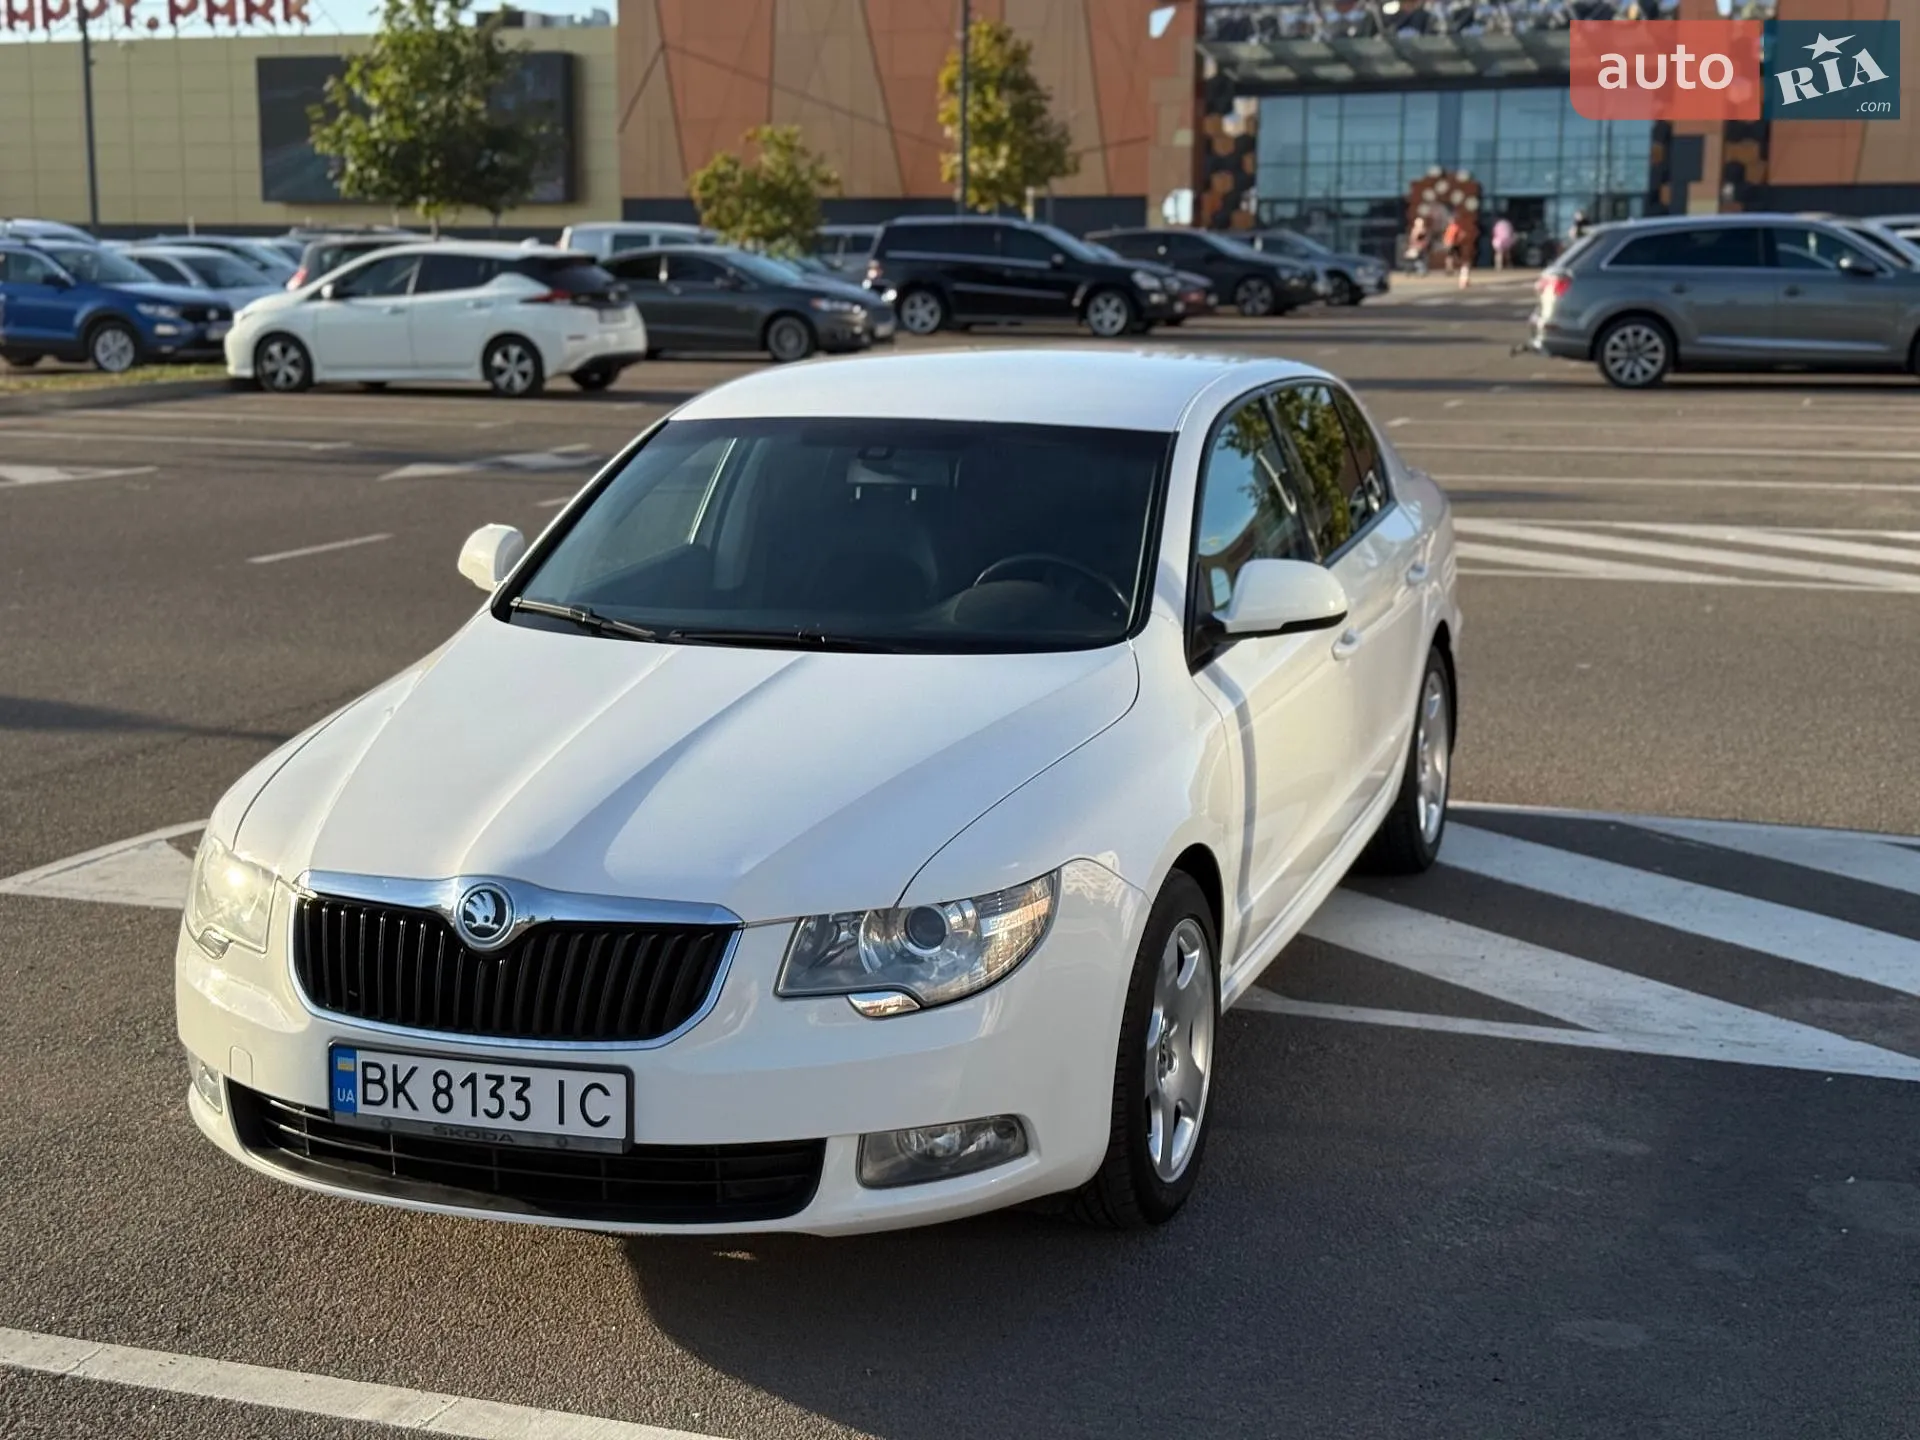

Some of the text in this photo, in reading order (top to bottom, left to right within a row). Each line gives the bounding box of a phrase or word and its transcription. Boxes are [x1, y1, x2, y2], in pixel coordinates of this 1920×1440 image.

[0, 0, 310, 32] APPY.PARK
[337, 1087, 355, 1104] UA
[361, 1061, 612, 1128] BK 8133 IC
